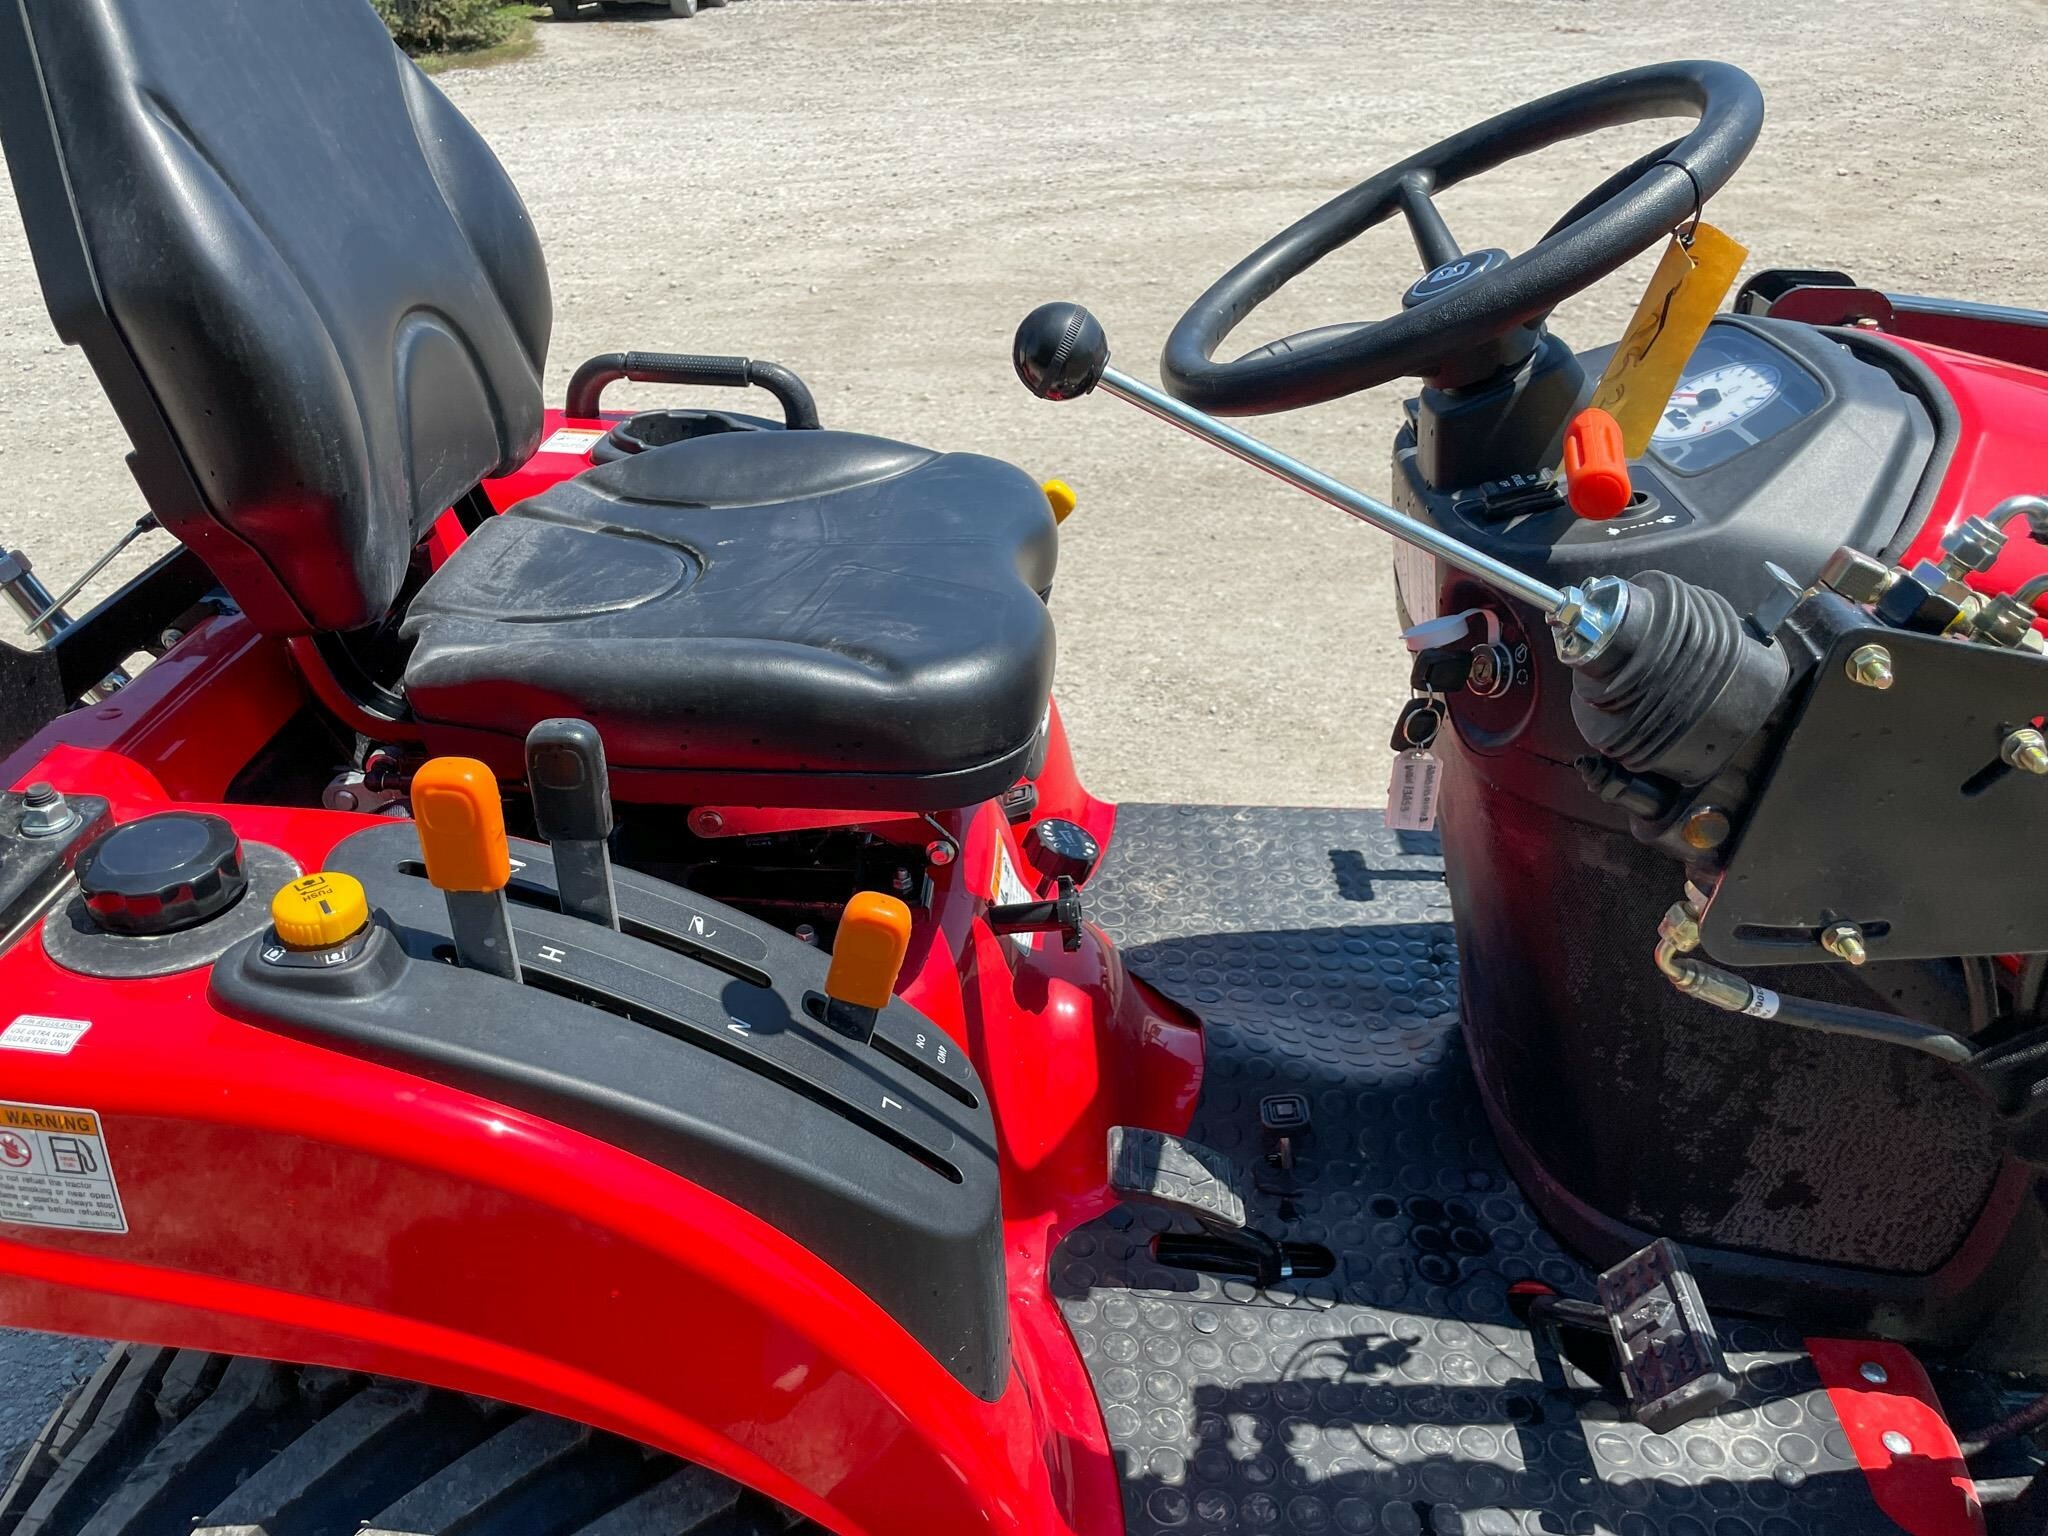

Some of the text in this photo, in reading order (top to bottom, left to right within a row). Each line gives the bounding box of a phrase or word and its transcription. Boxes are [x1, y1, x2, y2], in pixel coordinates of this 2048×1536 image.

[303, 888, 333, 903] PUSH
[538, 945, 566, 963] H
[27, 1029, 51, 1037] ULTRA
[727, 1016, 752, 1037] N
[32, 1037, 49, 1045] FUEL
[50, 1039, 70, 1047] ONLY
[916, 1033, 927, 1049] ON
[937, 1044, 948, 1064] 4WD
[881, 1096, 903, 1110] L
[4, 1109, 90, 1132] WARNING
[65, 1180, 92, 1189] tractor
[67, 1190, 85, 1198] near
[90, 1192, 112, 1200] open
[65, 1198, 93, 1207] Always
[97, 1201, 114, 1209] stop
[48, 1205, 75, 1214] before
[79, 1209, 116, 1219] refueling
